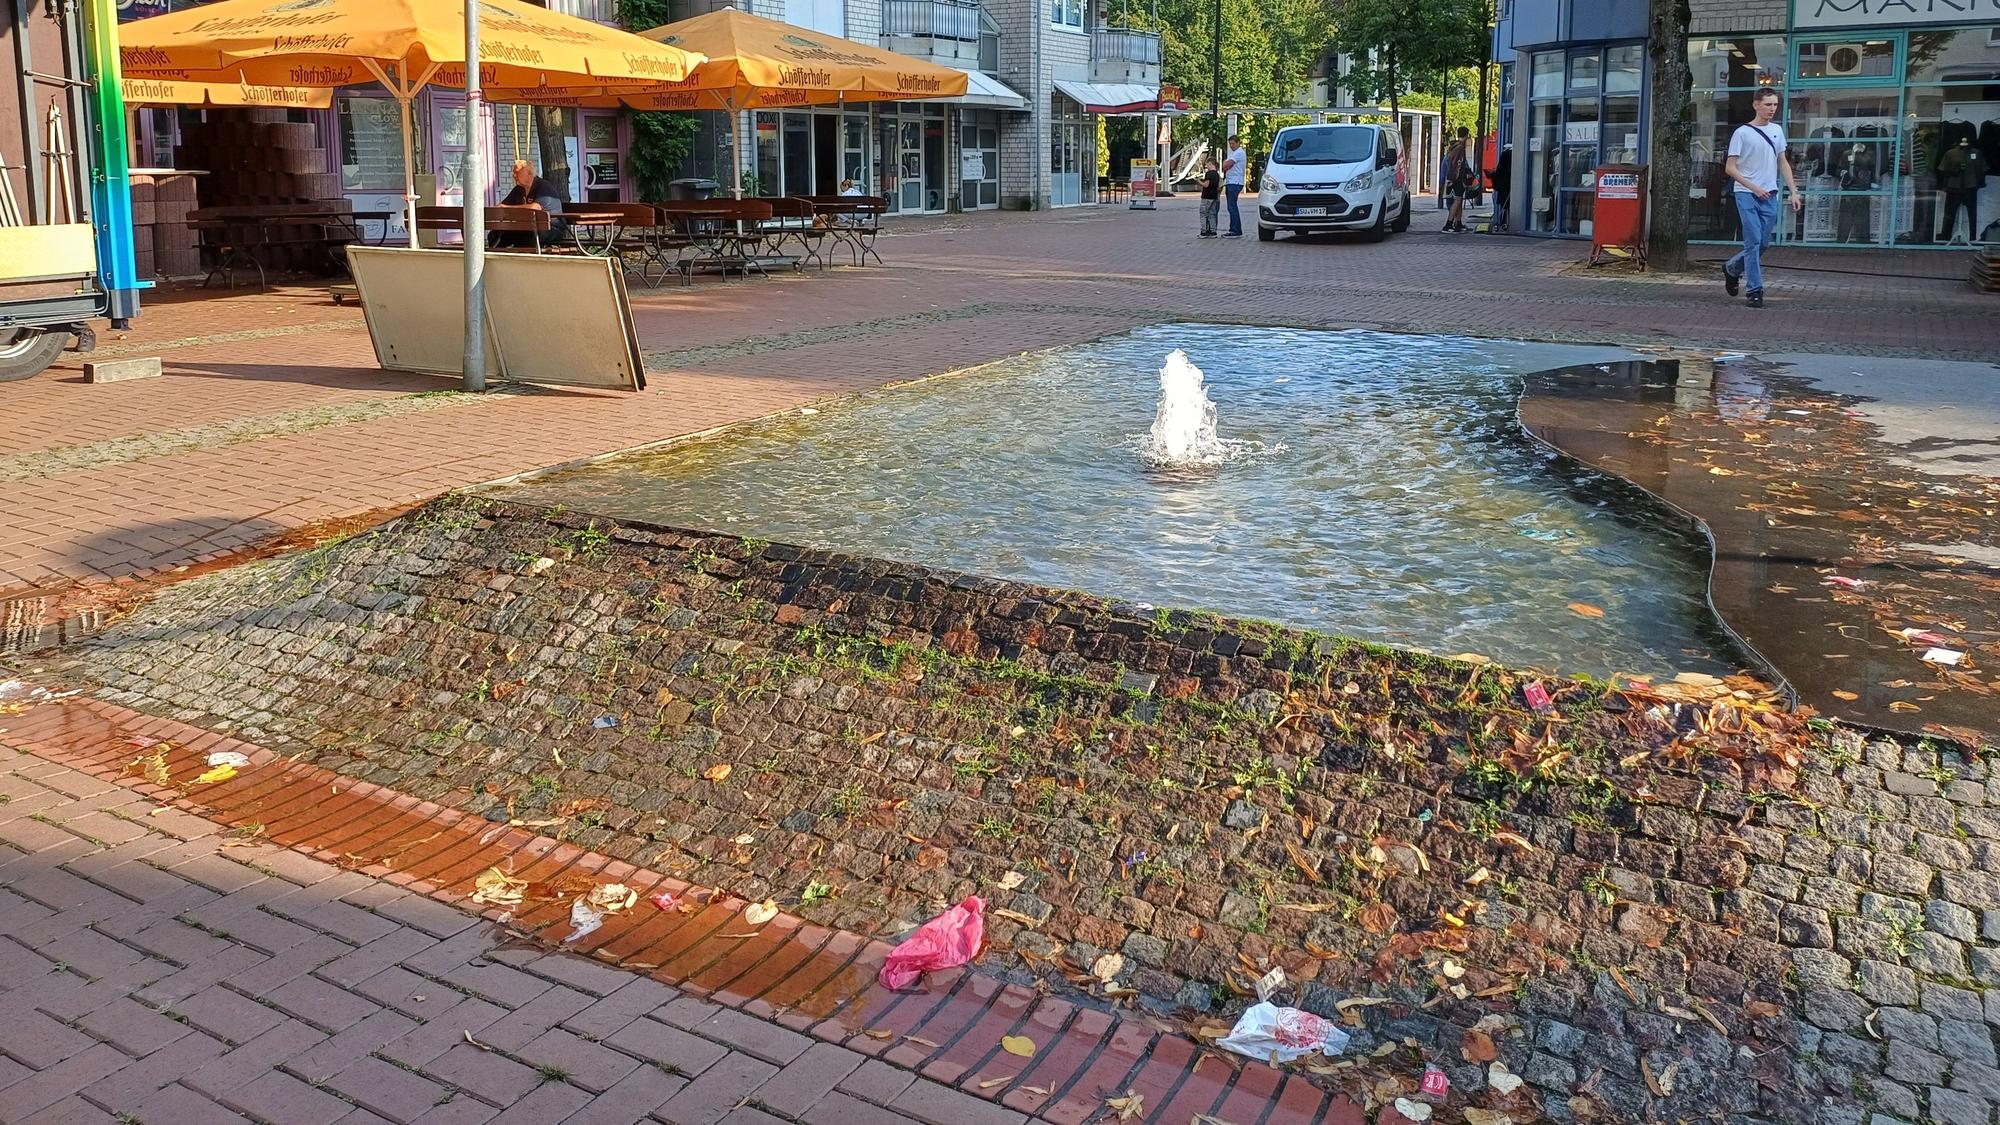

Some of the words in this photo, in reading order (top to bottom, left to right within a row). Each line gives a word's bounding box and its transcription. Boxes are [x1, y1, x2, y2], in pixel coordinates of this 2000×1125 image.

[264, 34, 354, 54] Schöfferhofer
[479, 40, 544, 65] Schöfferhofer
[622, 51, 678, 77] Schöfferhofer
[778, 65, 831, 88] Schöfferhofer
[896, 72, 941, 93] Schöfferhofer
[240, 83, 308, 103] Schöfferhofer
